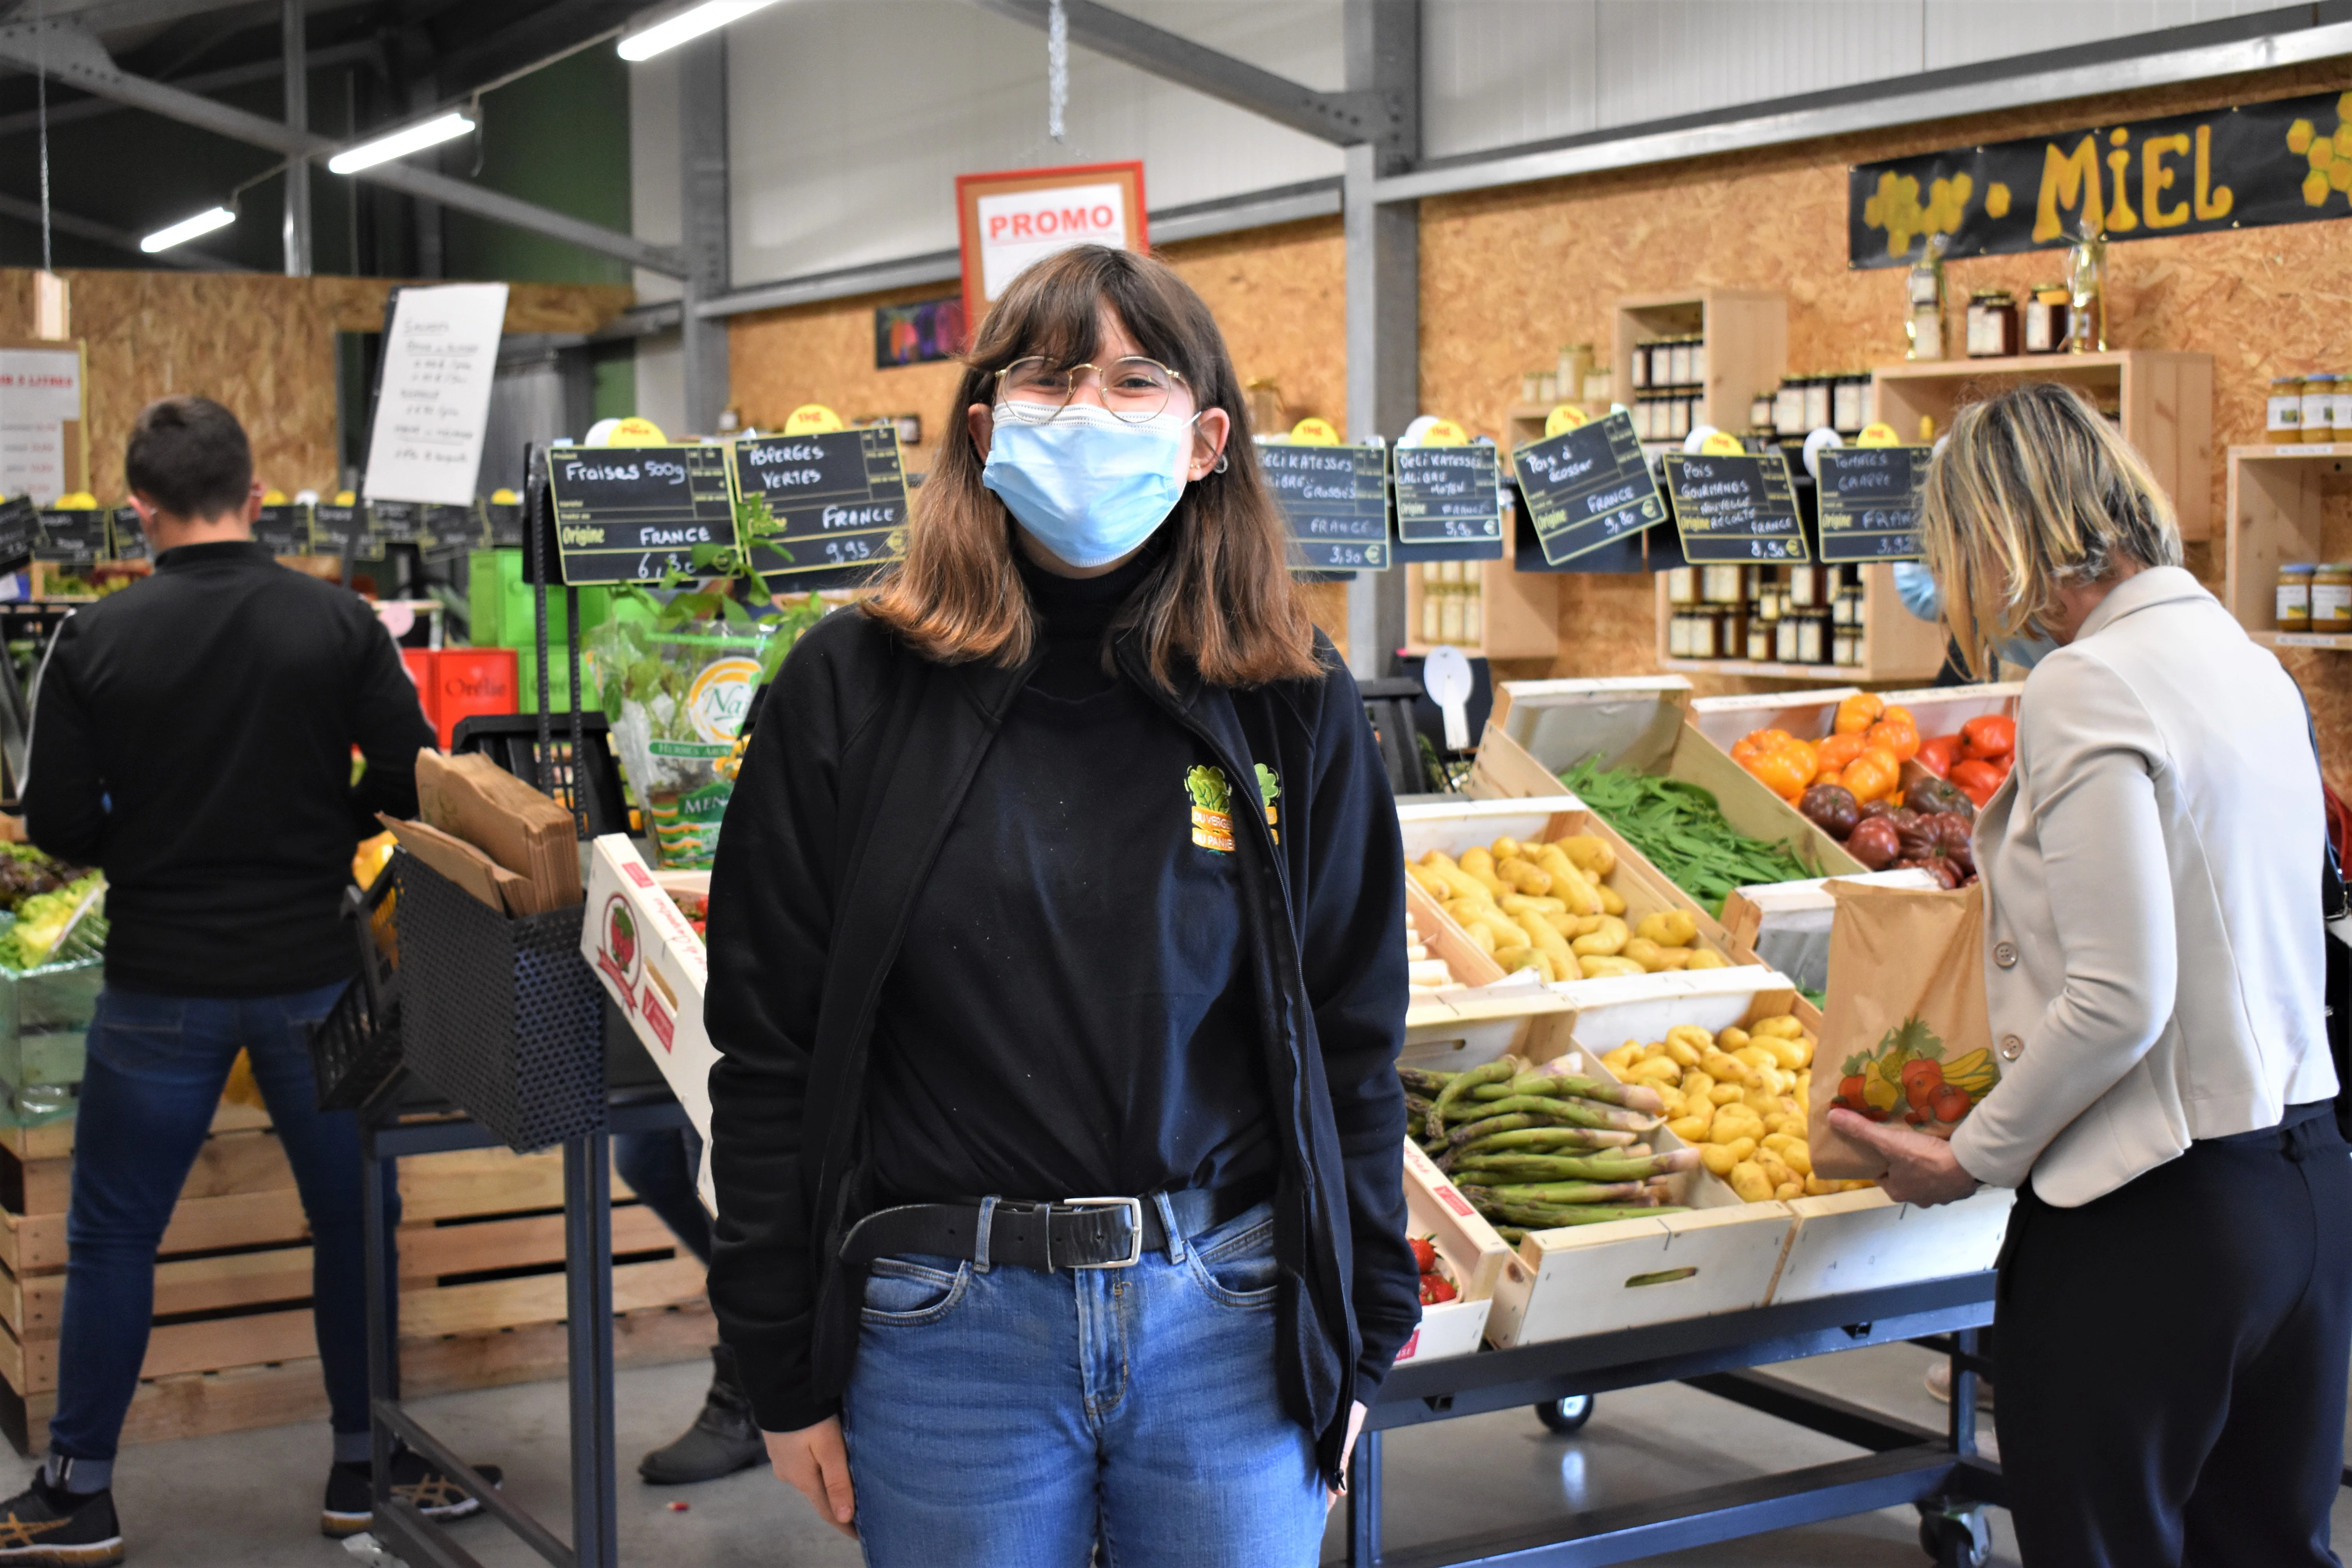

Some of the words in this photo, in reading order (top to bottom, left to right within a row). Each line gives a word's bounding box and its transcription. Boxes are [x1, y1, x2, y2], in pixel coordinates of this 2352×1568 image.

[989, 206, 1114, 238] PROMO
[566, 461, 640, 481] Fraises
[644, 460, 686, 485] 500g
[762, 469, 821, 489] VERTES
[1587, 486, 1635, 514] FRANCE
[822, 505, 894, 528] FRANCE
[1537, 509, 1567, 530] Origine
[1681, 515, 1711, 532] Origine
[1822, 512, 1852, 530] Origine
[562, 525, 605, 546] Origine
[640, 527, 710, 545] FRANCE
[826, 541, 870, 564] 9,95
[1330, 545, 1362, 564] 3,90
[706, 684, 746, 714] Na
[1194, 811, 1205, 823] DU
